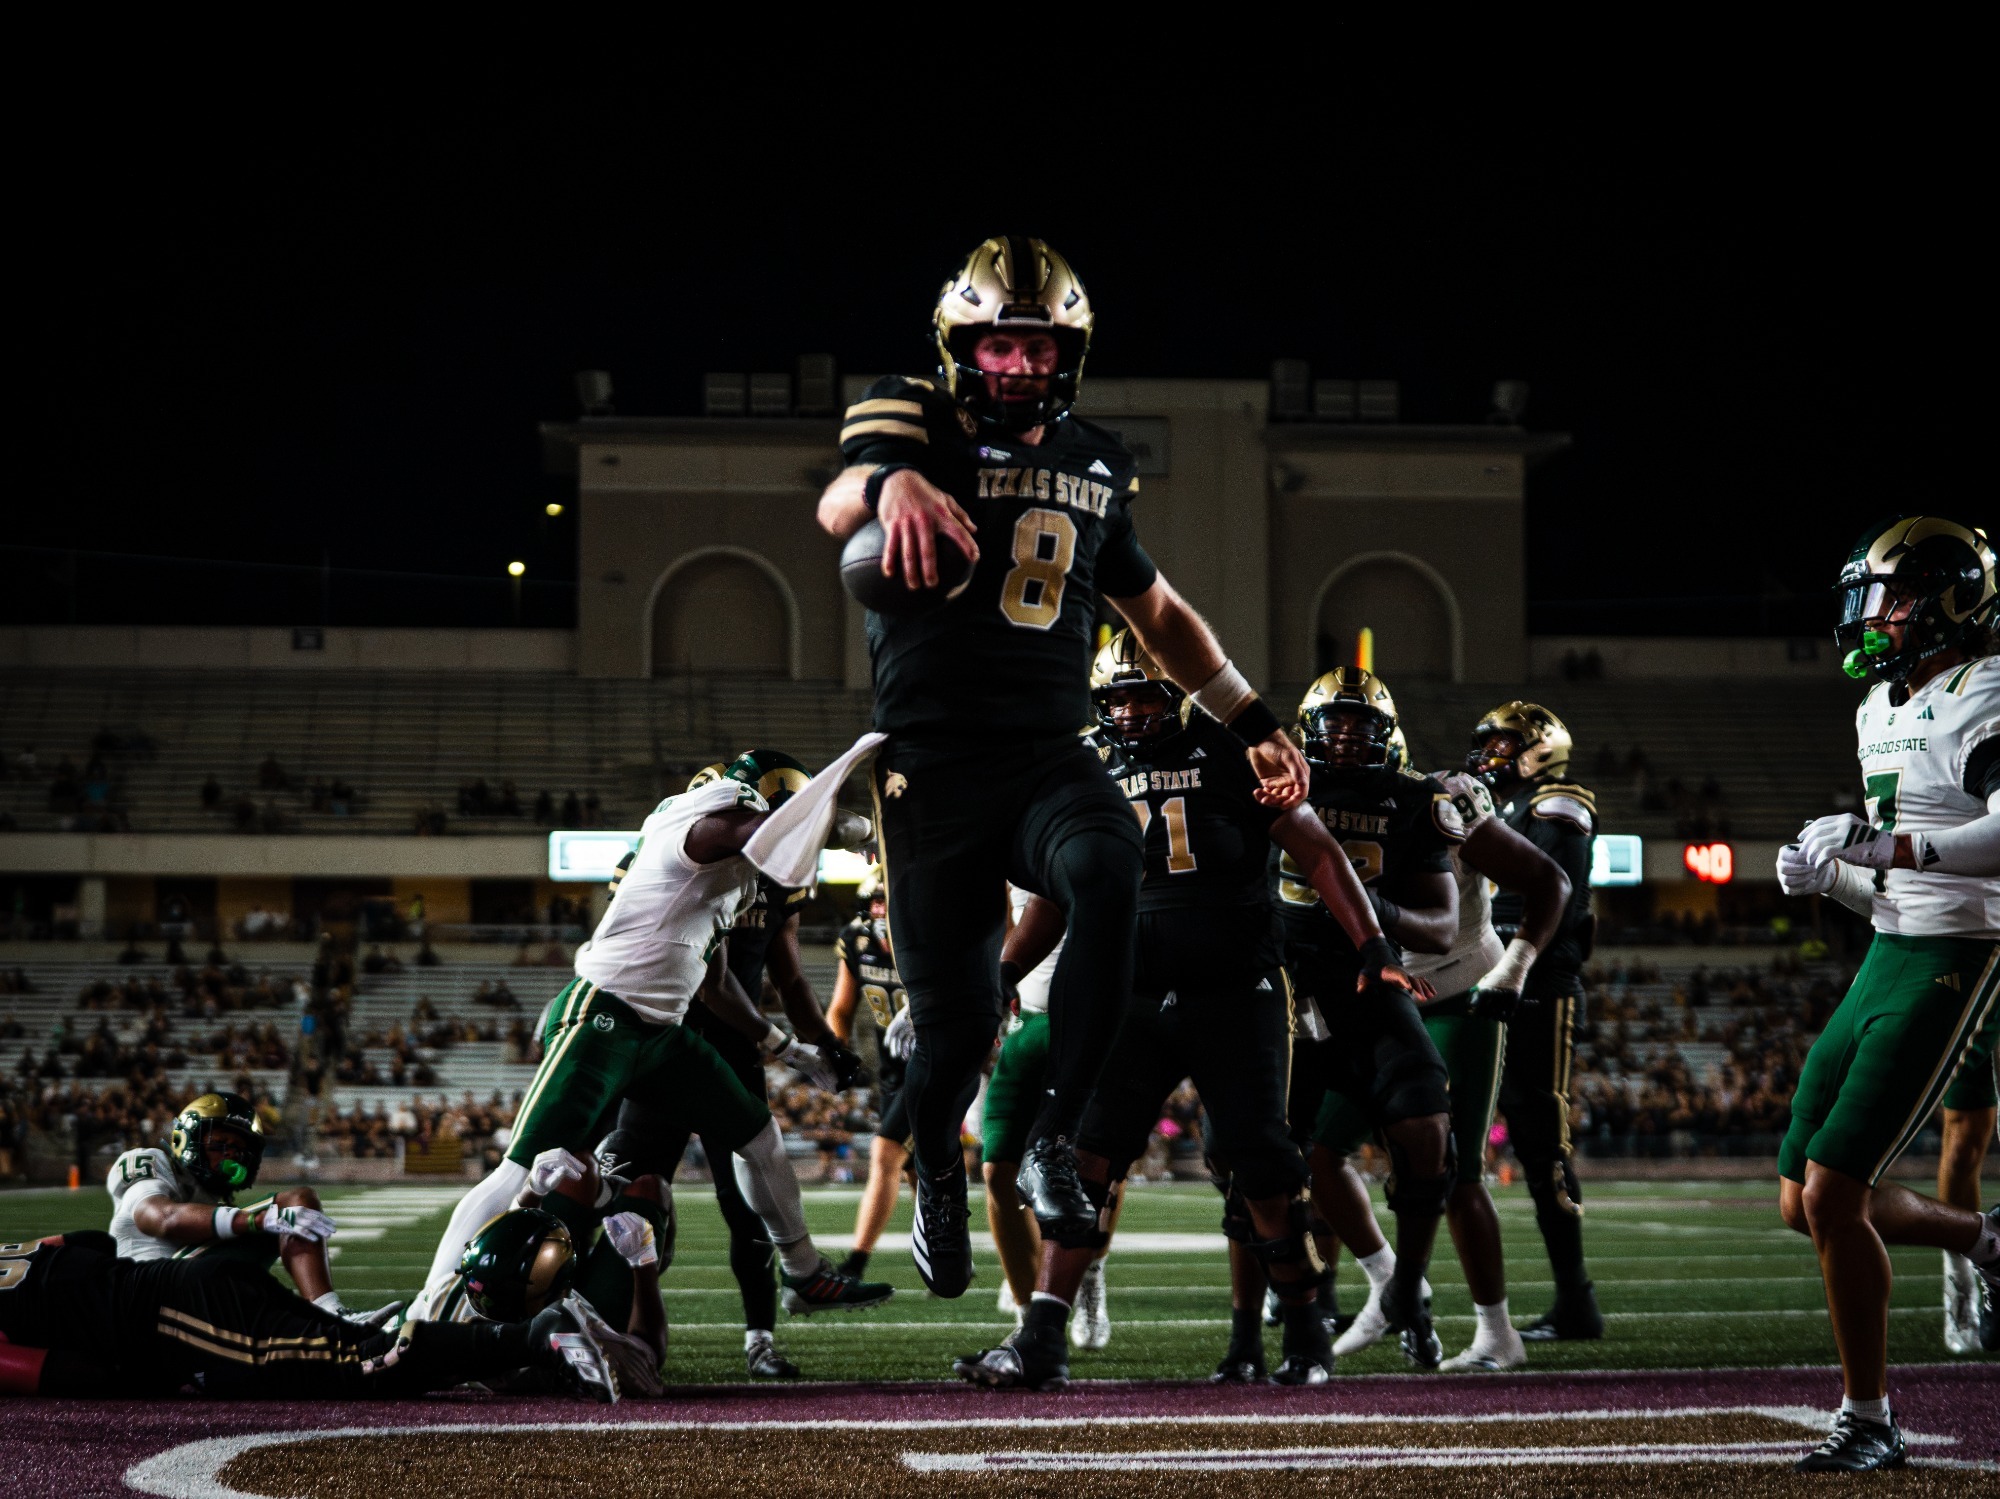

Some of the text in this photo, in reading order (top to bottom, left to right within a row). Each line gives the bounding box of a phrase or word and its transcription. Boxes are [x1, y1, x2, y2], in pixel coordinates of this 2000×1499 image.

[977, 467, 1113, 519] TEXAS STATE
[999, 507, 1078, 630] 8
[1859, 738, 1927, 760] OLORADO STATE
[1117, 772, 1148, 799] XAS
[1150, 768, 1201, 790] STATE
[1339, 810, 1389, 835] STATE
[1864, 768, 1903, 897] 7
[118, 1155, 156, 1183] 15
